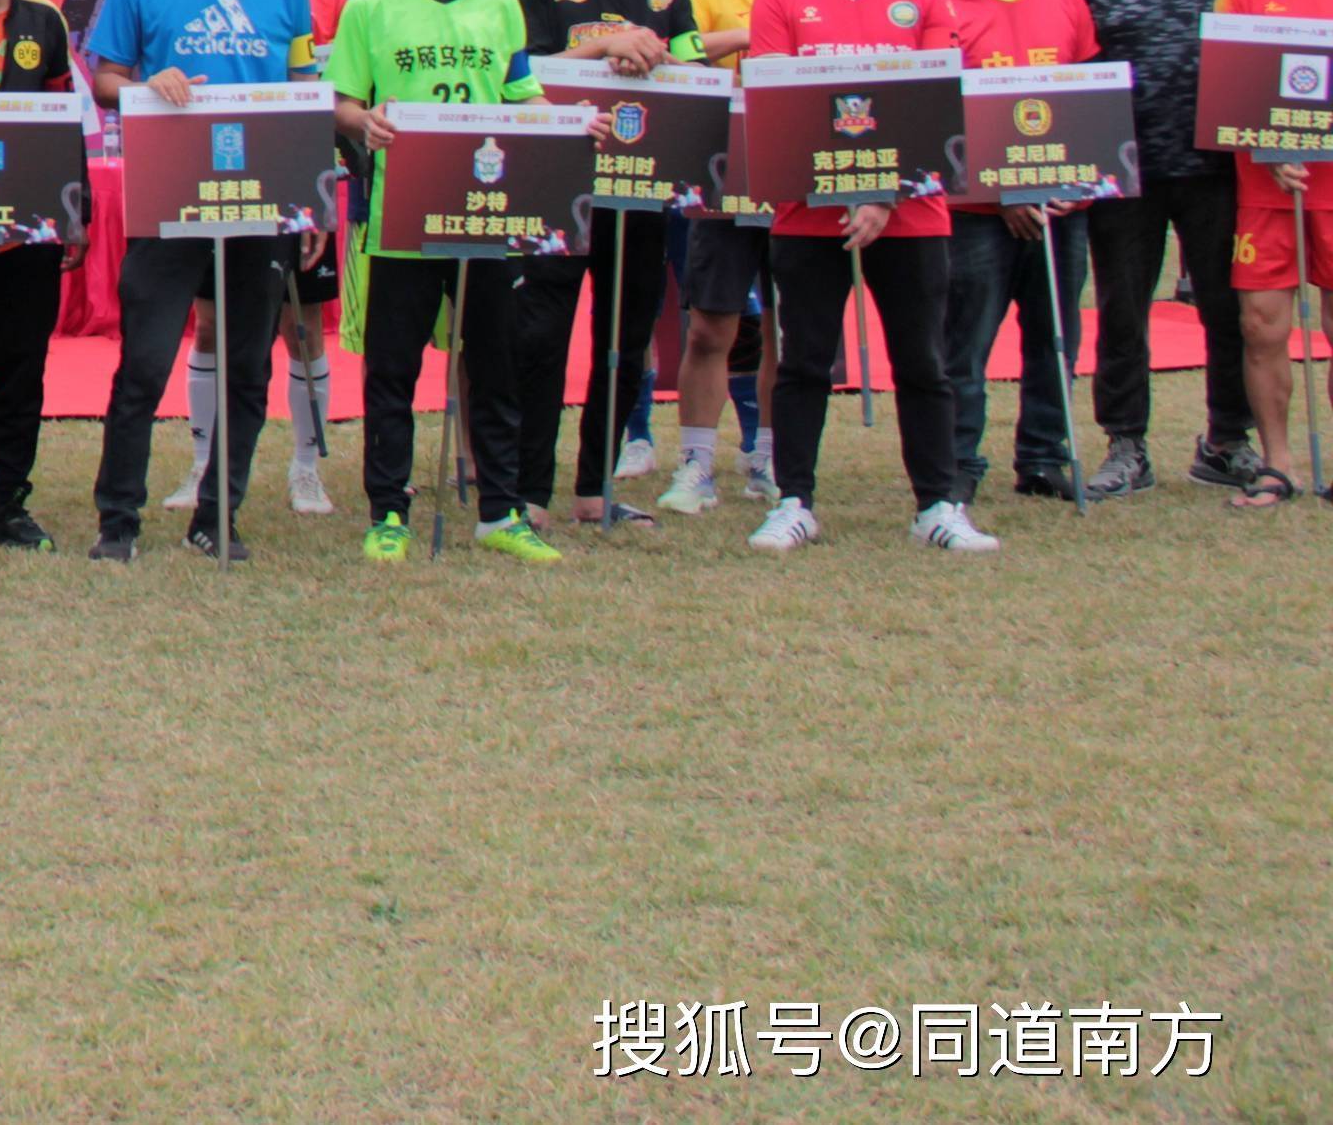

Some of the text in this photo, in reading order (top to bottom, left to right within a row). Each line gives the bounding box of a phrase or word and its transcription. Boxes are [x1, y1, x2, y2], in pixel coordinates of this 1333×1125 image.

[174, 34, 269, 58] adidas
[1269, 106, 1333, 131] 西班牙
[594, 153, 656, 177] 比利时
[813, 147, 899, 171] 克罗地亚
[1006, 143, 1066, 164] 突尼斯
[465, 191, 508, 212] 沙特
